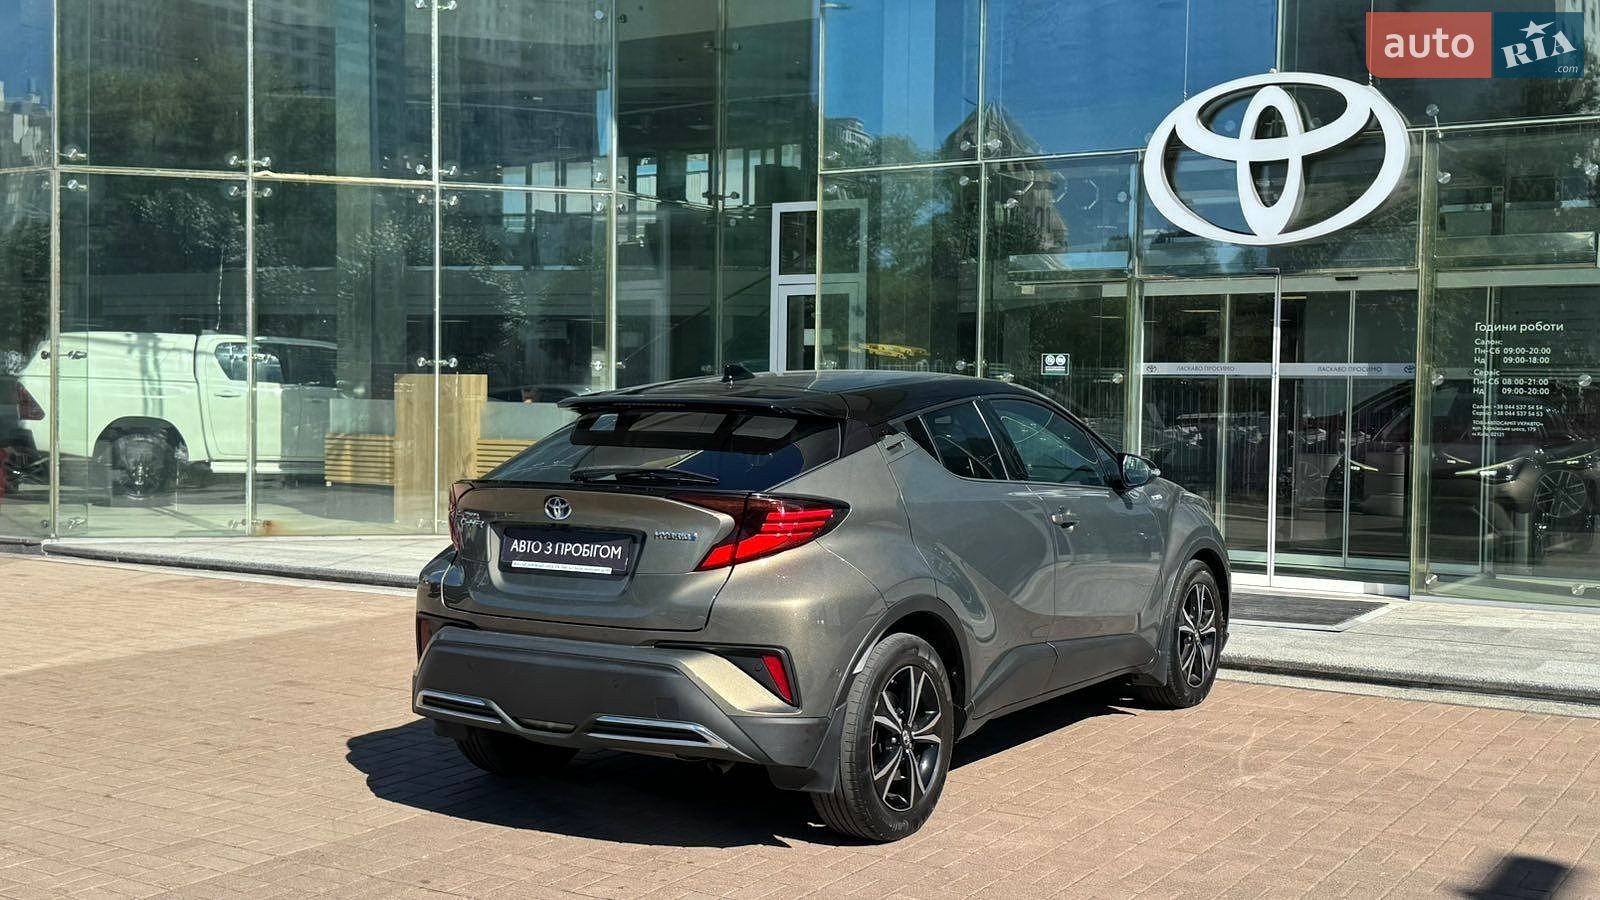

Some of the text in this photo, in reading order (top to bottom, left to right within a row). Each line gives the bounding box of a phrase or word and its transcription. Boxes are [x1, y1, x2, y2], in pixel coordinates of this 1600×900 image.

[1475, 321, 1564, 334] Години роботи
[1503, 347, 1552, 355] 09:00-20:00
[1501, 378, 1549, 386] 08:00-21:00
[1501, 387, 1550, 395] 09:00-20:00
[510, 539, 542, 554] АВТО
[554, 542, 622, 560] ПРОБІГОМ
